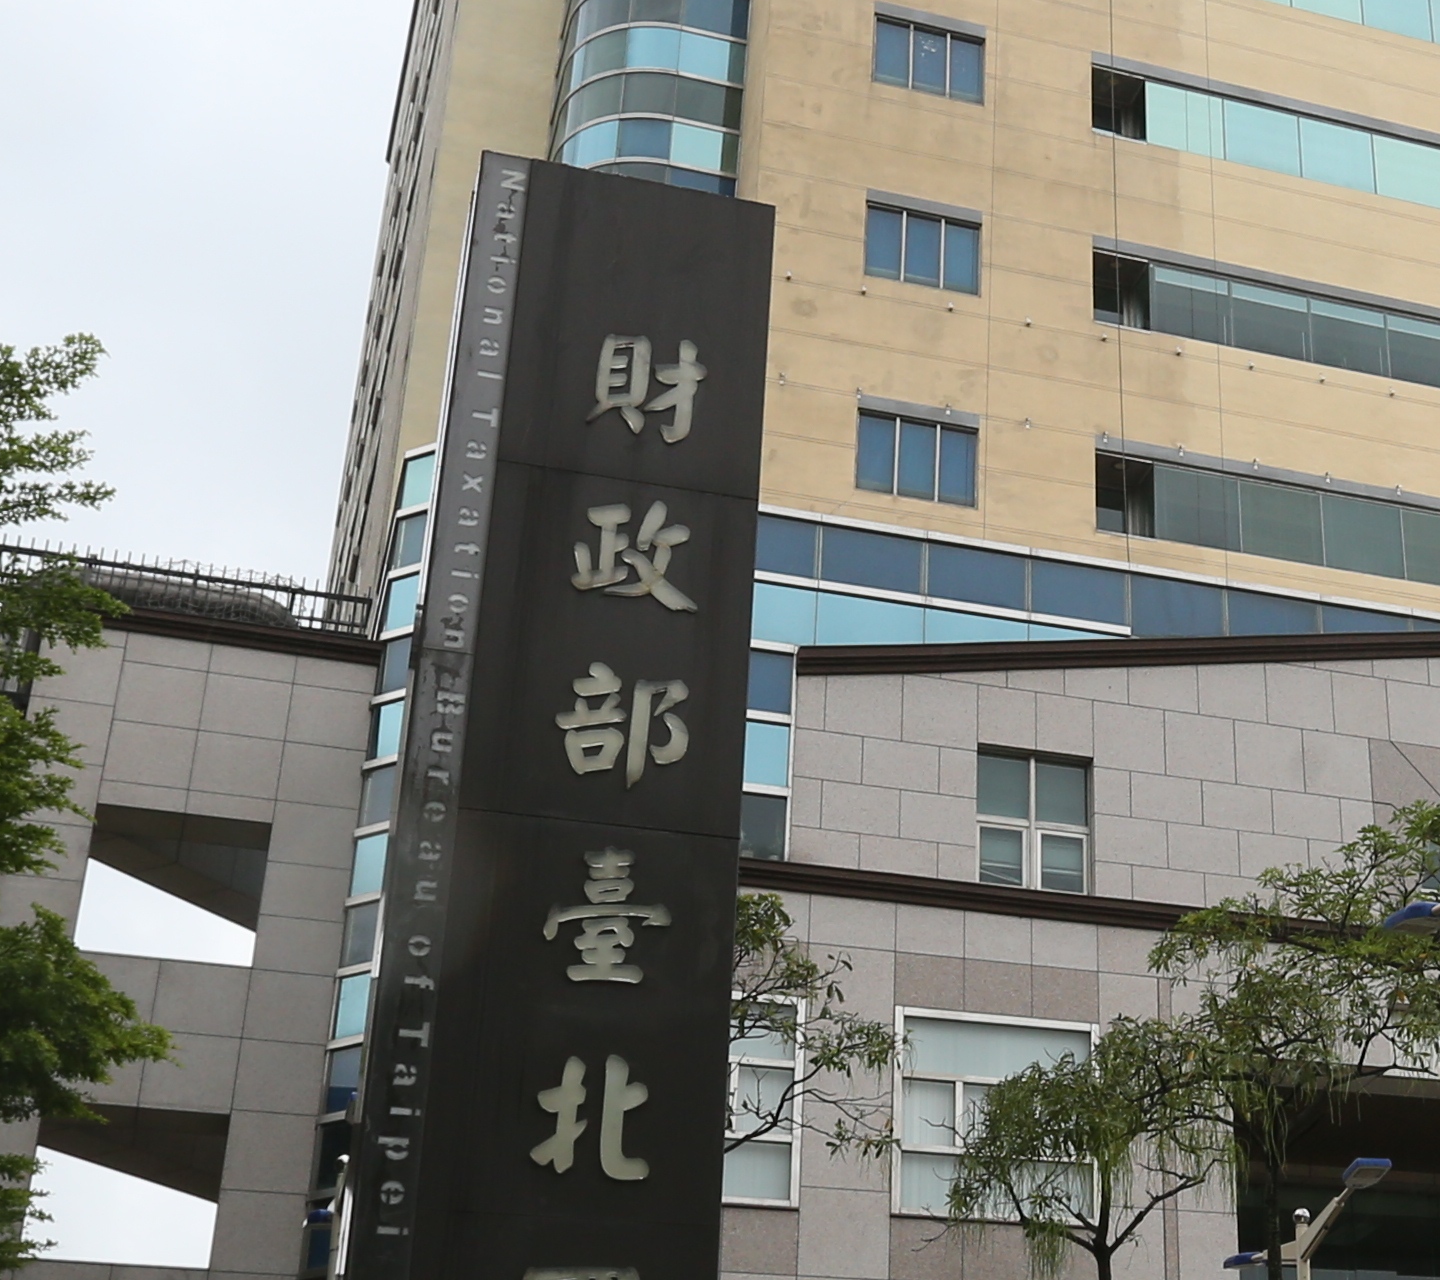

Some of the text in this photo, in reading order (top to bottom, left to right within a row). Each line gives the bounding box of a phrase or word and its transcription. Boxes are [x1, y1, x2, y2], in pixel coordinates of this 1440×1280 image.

[477, 167, 527, 381] National
[443, 407, 499, 651] Taxation
[413, 688, 466, 904] Bureau
[403, 934, 435, 993] of
[376, 1021, 429, 1237] Taipei
